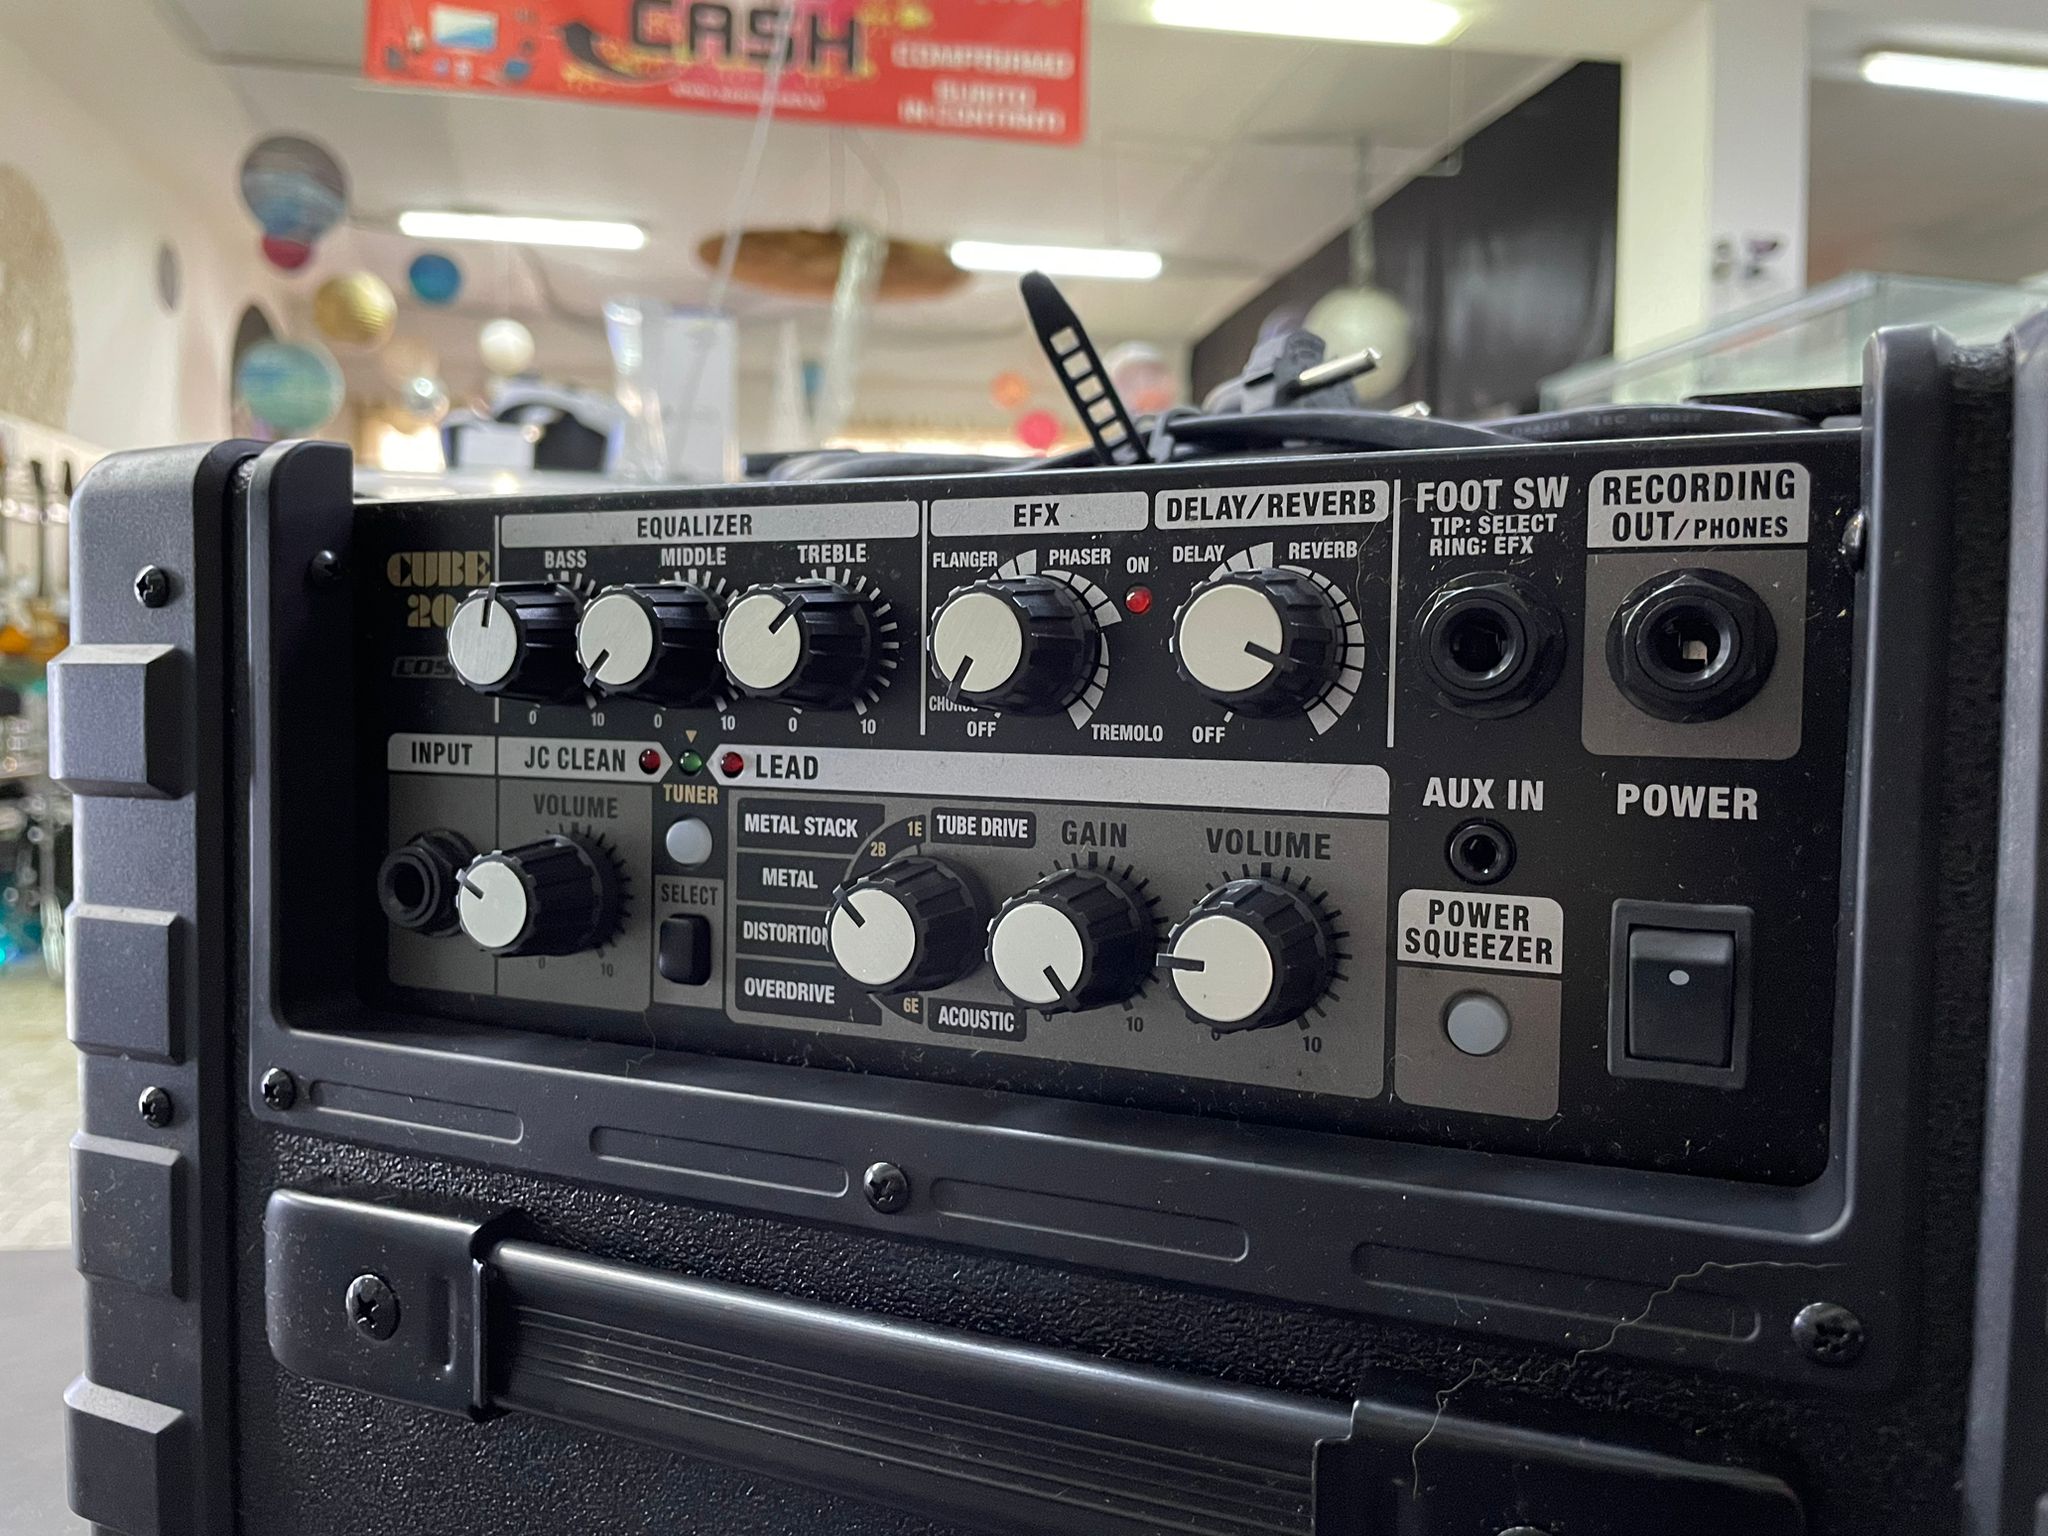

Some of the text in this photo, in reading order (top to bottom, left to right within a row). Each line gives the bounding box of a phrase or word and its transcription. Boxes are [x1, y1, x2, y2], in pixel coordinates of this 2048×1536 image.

[632, 0, 855, 77] CASH
[1416, 476, 1569, 513] FOOT SW
[1602, 469, 1796, 506] RECORDING
[1013, 502, 1060, 528] EFX
[1166, 489, 1376, 522] DELAY/REVERB
[637, 513, 753, 539] EQUALIZER
[1431, 513, 1558, 536] TIP: SELECT
[661, 546, 727, 567] MIDDLE
[797, 543, 867, 564] TREBLE
[1049, 548, 1111, 566] PHASER
[1172, 545, 1225, 563] DELAY
[1289, 540, 1358, 560] REVERB
[1429, 536, 1534, 557] RING: EFX
[387, 551, 491, 588] CUBE
[545, 550, 587, 569] BASS
[932, 550, 998, 569] FLANGER
[1126, 556, 1149, 574] ON
[396, 659, 452, 675] COS
[529, 710, 605, 726] 0 10
[654, 713, 736, 731] 0 10
[788, 717, 877, 735] 0 10
[967, 721, 997, 738] OFF
[1091, 724, 1163, 743] TREMOLO
[1191, 726, 1226, 743] OFF
[411, 741, 473, 766] INPUT
[524, 746, 626, 772] JC CLEAN
[755, 754, 819, 780] LEAD
[663, 783, 718, 805] TUNER
[1422, 776, 1544, 811] AUX IN
[1616, 783, 1758, 820] POWER
[533, 793, 619, 819] VOLUME
[744, 813, 858, 838] METAL STACK
[907, 821, 922, 837] 1E
[936, 814, 1028, 839] TUBE DRIVE
[1061, 820, 1127, 847] GAIN
[870, 841, 886, 857] 2B
[1206, 827, 1331, 860] VOLUME
[762, 867, 818, 889] METAL
[661, 883, 718, 906] SELECT
[1428, 899, 1530, 932] POWER
[1405, 927, 1553, 965] SQUEEZER
[601, 963, 614, 977] 10
[744, 977, 835, 1005] OVERDRIVE
[903, 997, 919, 1014] 6E
[938, 1005, 1015, 1032] ACOUSTIC
[1126, 1016, 1144, 1032] 10
[1303, 1036, 1322, 1053] 10
